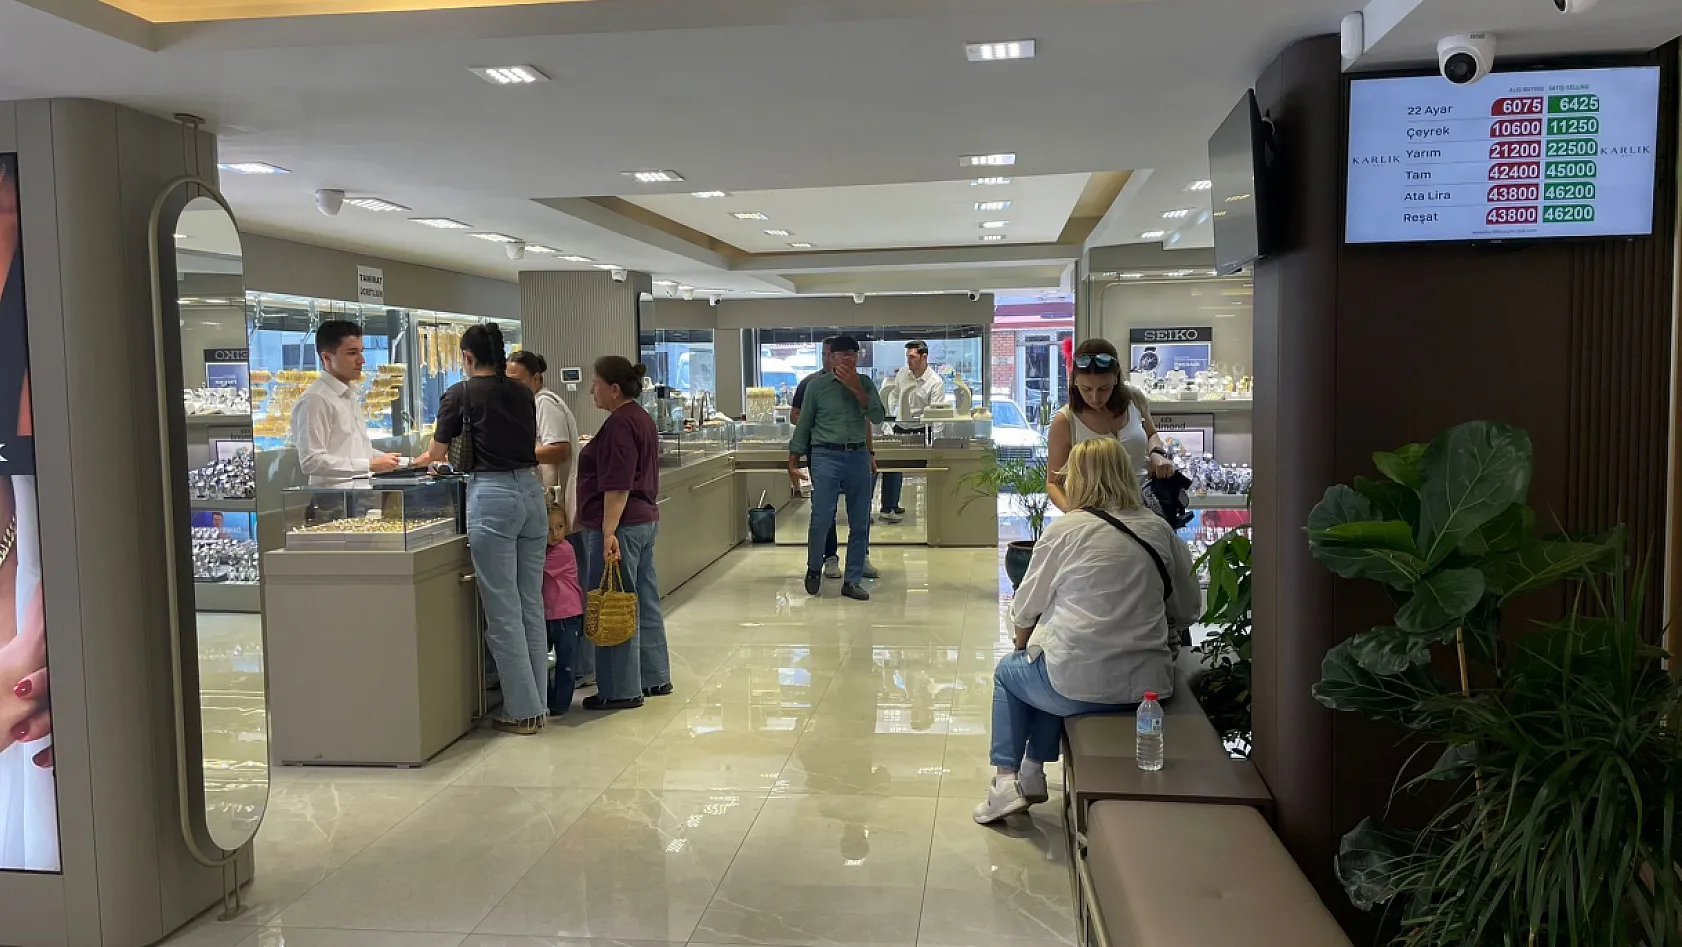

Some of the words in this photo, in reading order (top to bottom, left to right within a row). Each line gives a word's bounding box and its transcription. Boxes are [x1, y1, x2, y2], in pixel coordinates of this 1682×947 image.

[1407, 106, 1422, 116] 22
[1424, 105, 1453, 117] Ayar
[1503, 99, 1542, 113] 6075
[1560, 97, 1599, 111] 6425
[1406, 126, 1450, 140] Çeyrek
[1492, 121, 1541, 136] 10600
[1550, 119, 1598, 134] 11250
[1405, 149, 1442, 158] Yarım
[1490, 143, 1540, 158] 21200
[1547, 141, 1596, 156] 22500
[1600, 145, 1650, 155] KARLIK
[1352, 155, 1400, 165] KARLIK
[1405, 170, 1432, 180] Tam
[1489, 165, 1538, 179] 42400
[1546, 162, 1596, 177] 45000
[1404, 192, 1425, 201] Ata
[1427, 190, 1451, 200] Lira
[1488, 187, 1537, 201] 43800
[1545, 184, 1594, 199] 46200
[1403, 212, 1439, 224] Reşat
[1487, 208, 1536, 222] 43800
[1543, 206, 1593, 221] 46200
[1144, 329, 1198, 341] SEIKO
